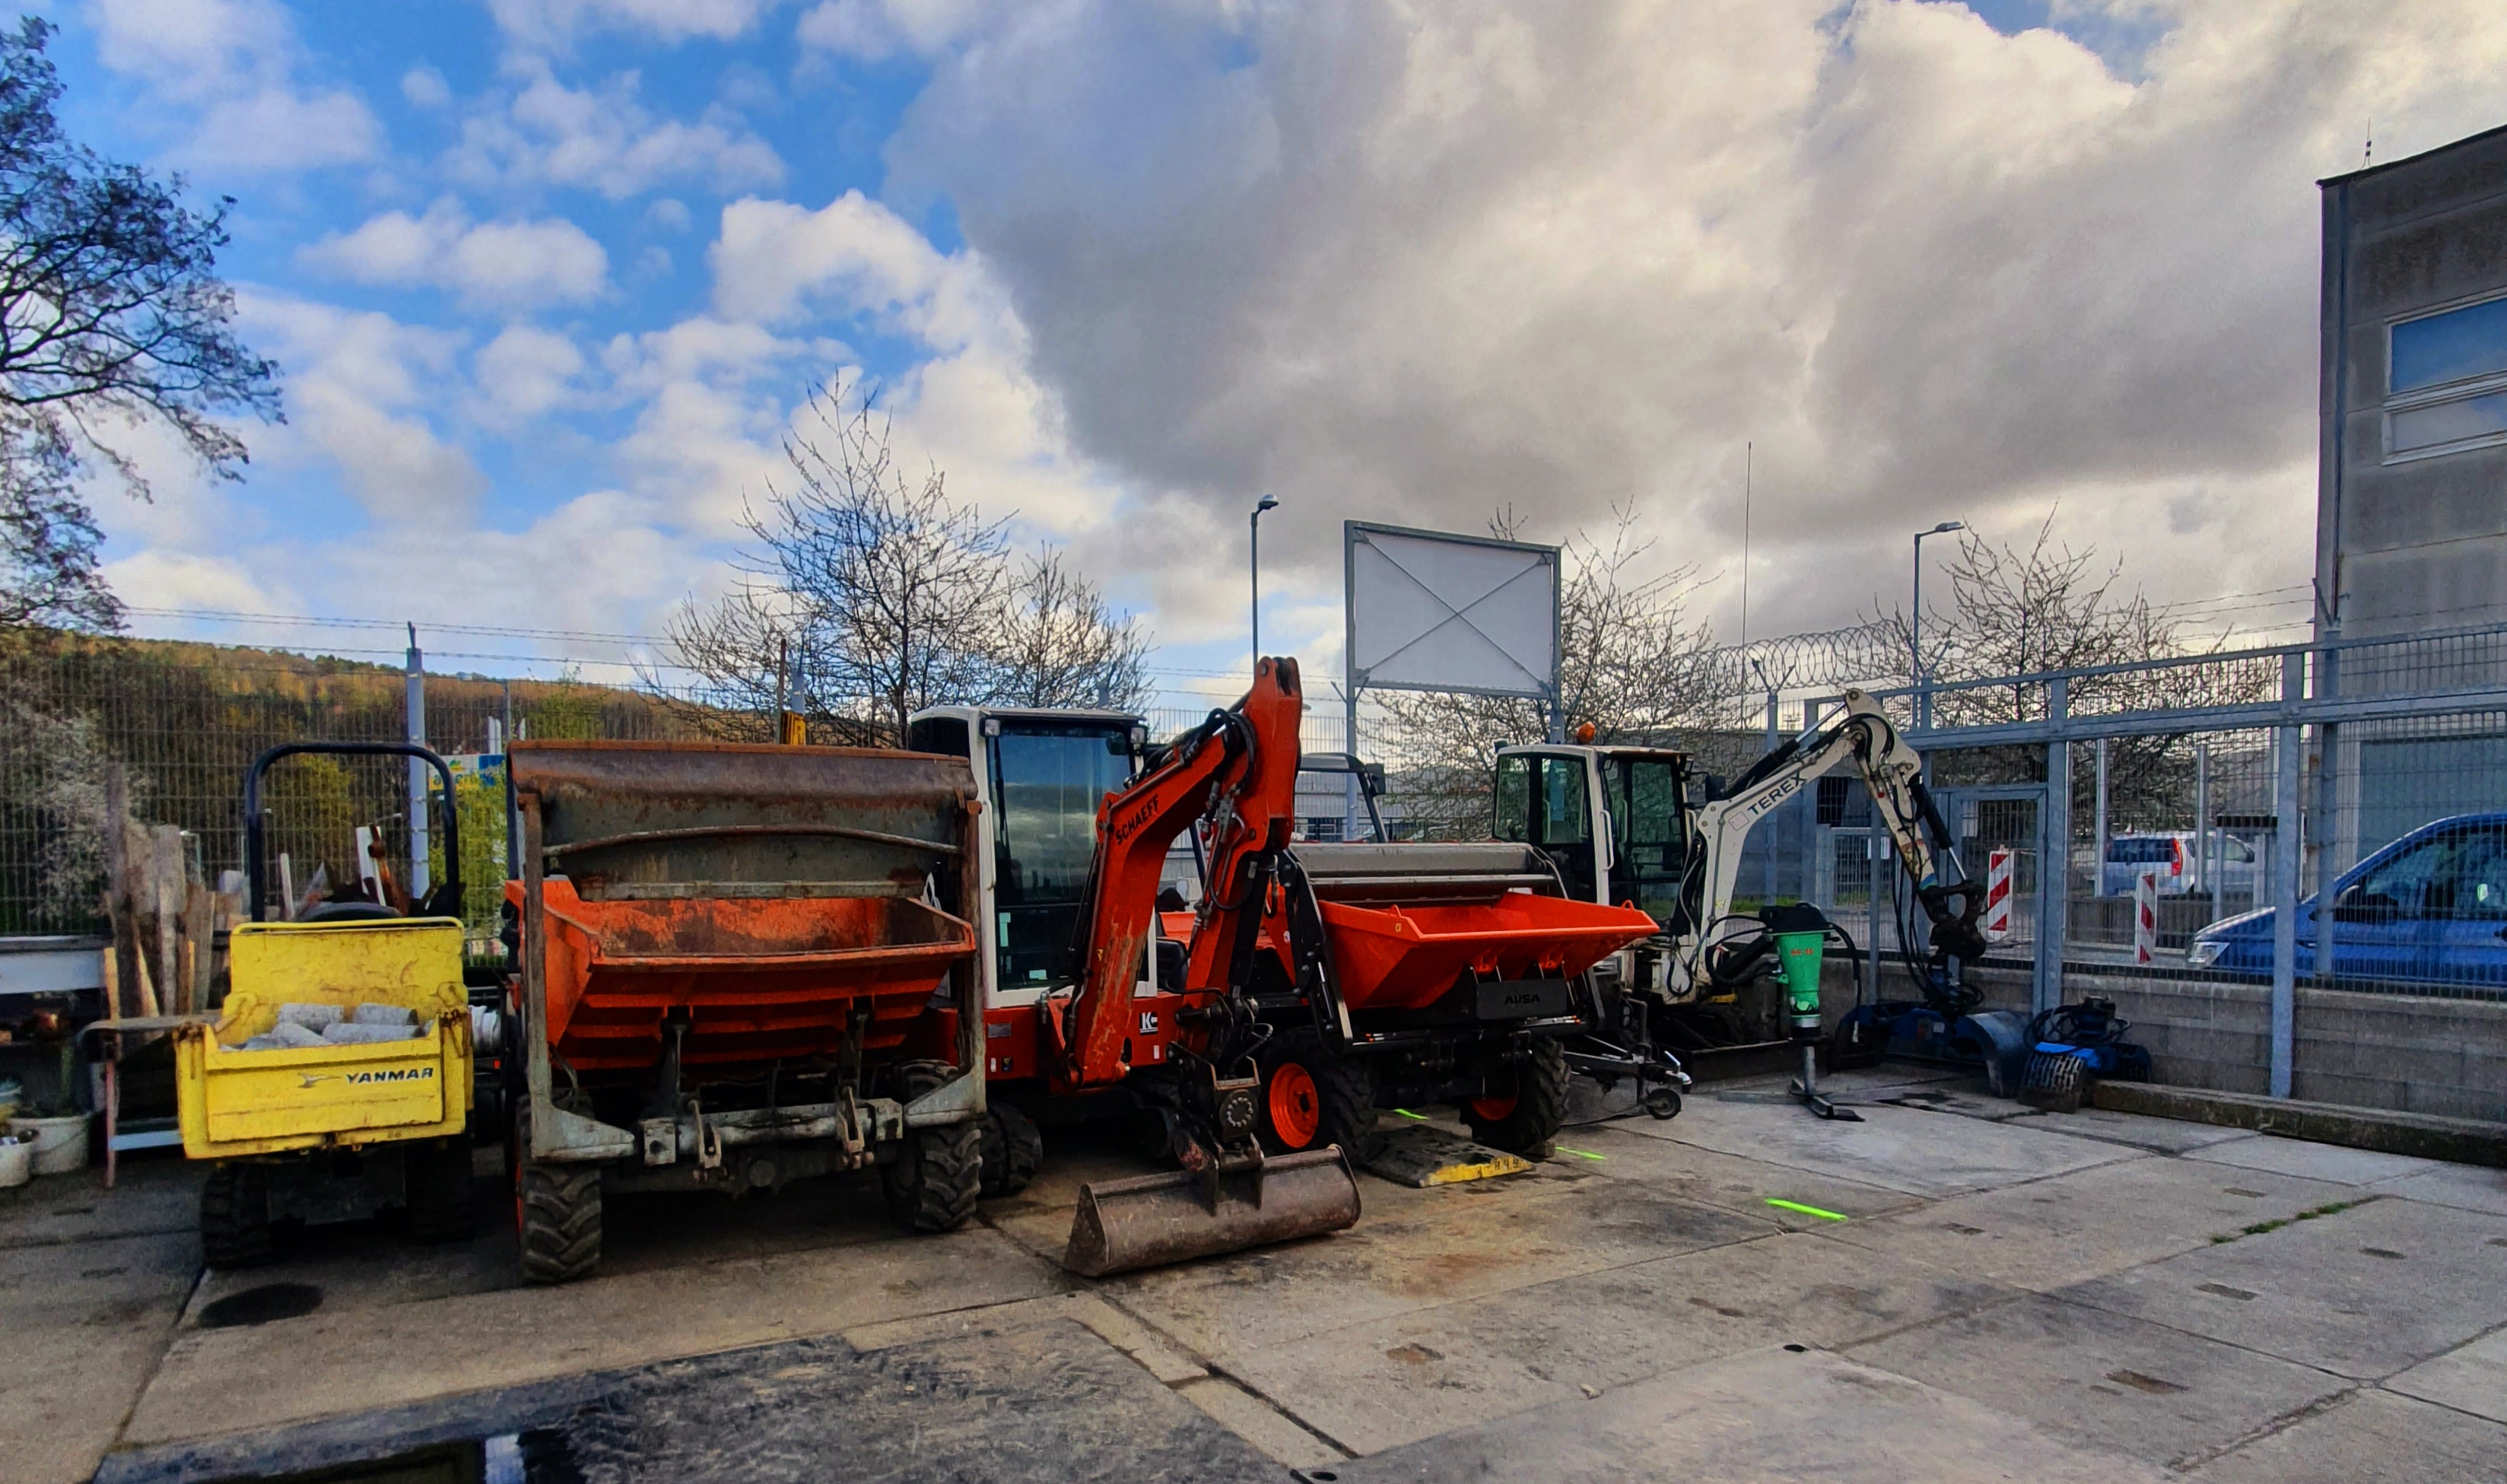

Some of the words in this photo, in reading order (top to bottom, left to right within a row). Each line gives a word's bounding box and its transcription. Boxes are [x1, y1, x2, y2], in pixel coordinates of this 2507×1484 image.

[1747, 771, 1807, 815] TEREX
[1115, 793, 1158, 846] SCHAEFF
[1504, 994, 1541, 1005] AUSA
[346, 1067, 434, 1084] YANMAR
